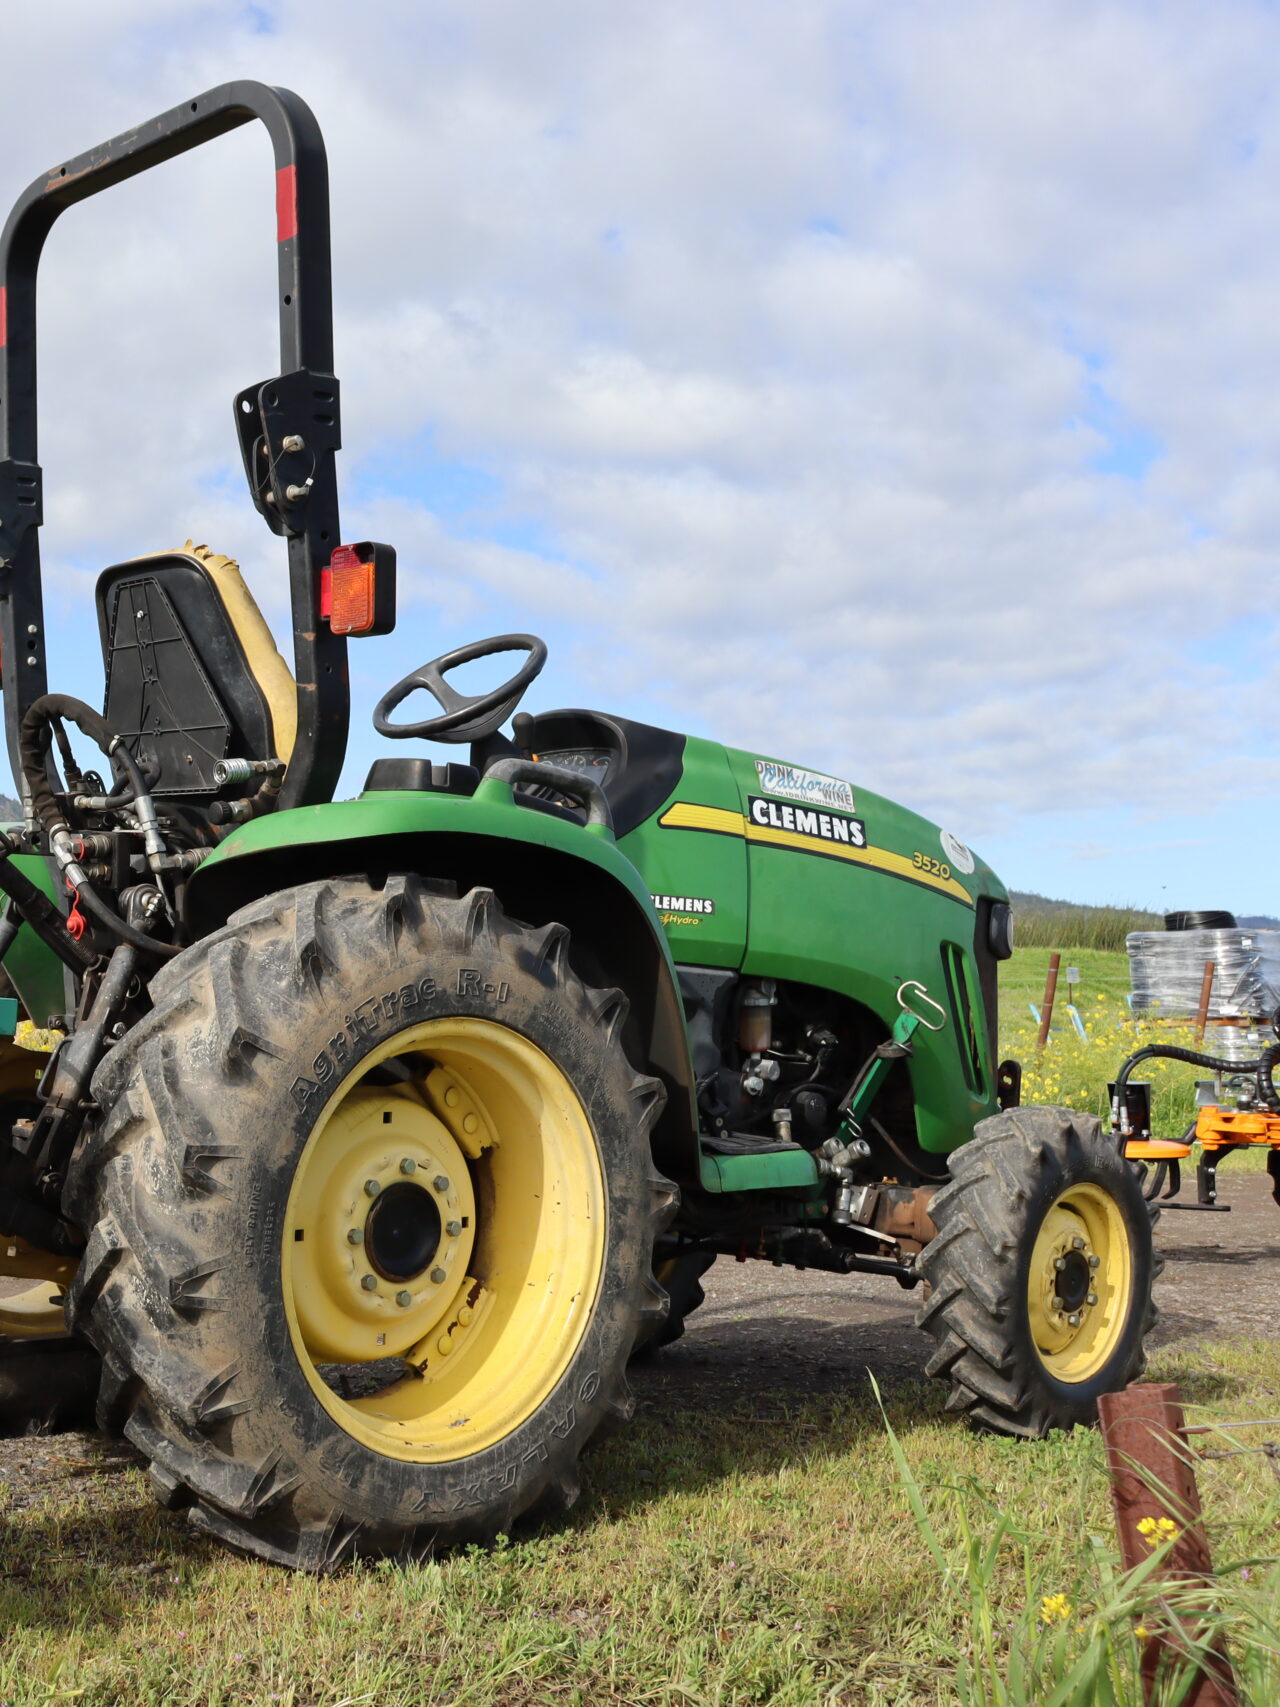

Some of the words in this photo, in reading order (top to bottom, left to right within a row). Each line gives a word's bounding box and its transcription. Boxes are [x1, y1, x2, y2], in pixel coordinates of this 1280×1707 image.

[756, 761, 796, 781] DRINK
[761, 767, 850, 796] California
[822, 788, 852, 806] WINE
[752, 799, 864, 846] CLEMENS
[912, 851, 952, 880] 3520
[650, 895, 713, 914] LEMENS
[288, 976, 437, 1115] AgriTrac
[246, 1182, 262, 1229] RATING
[409, 1370, 601, 1514] GALAXY
